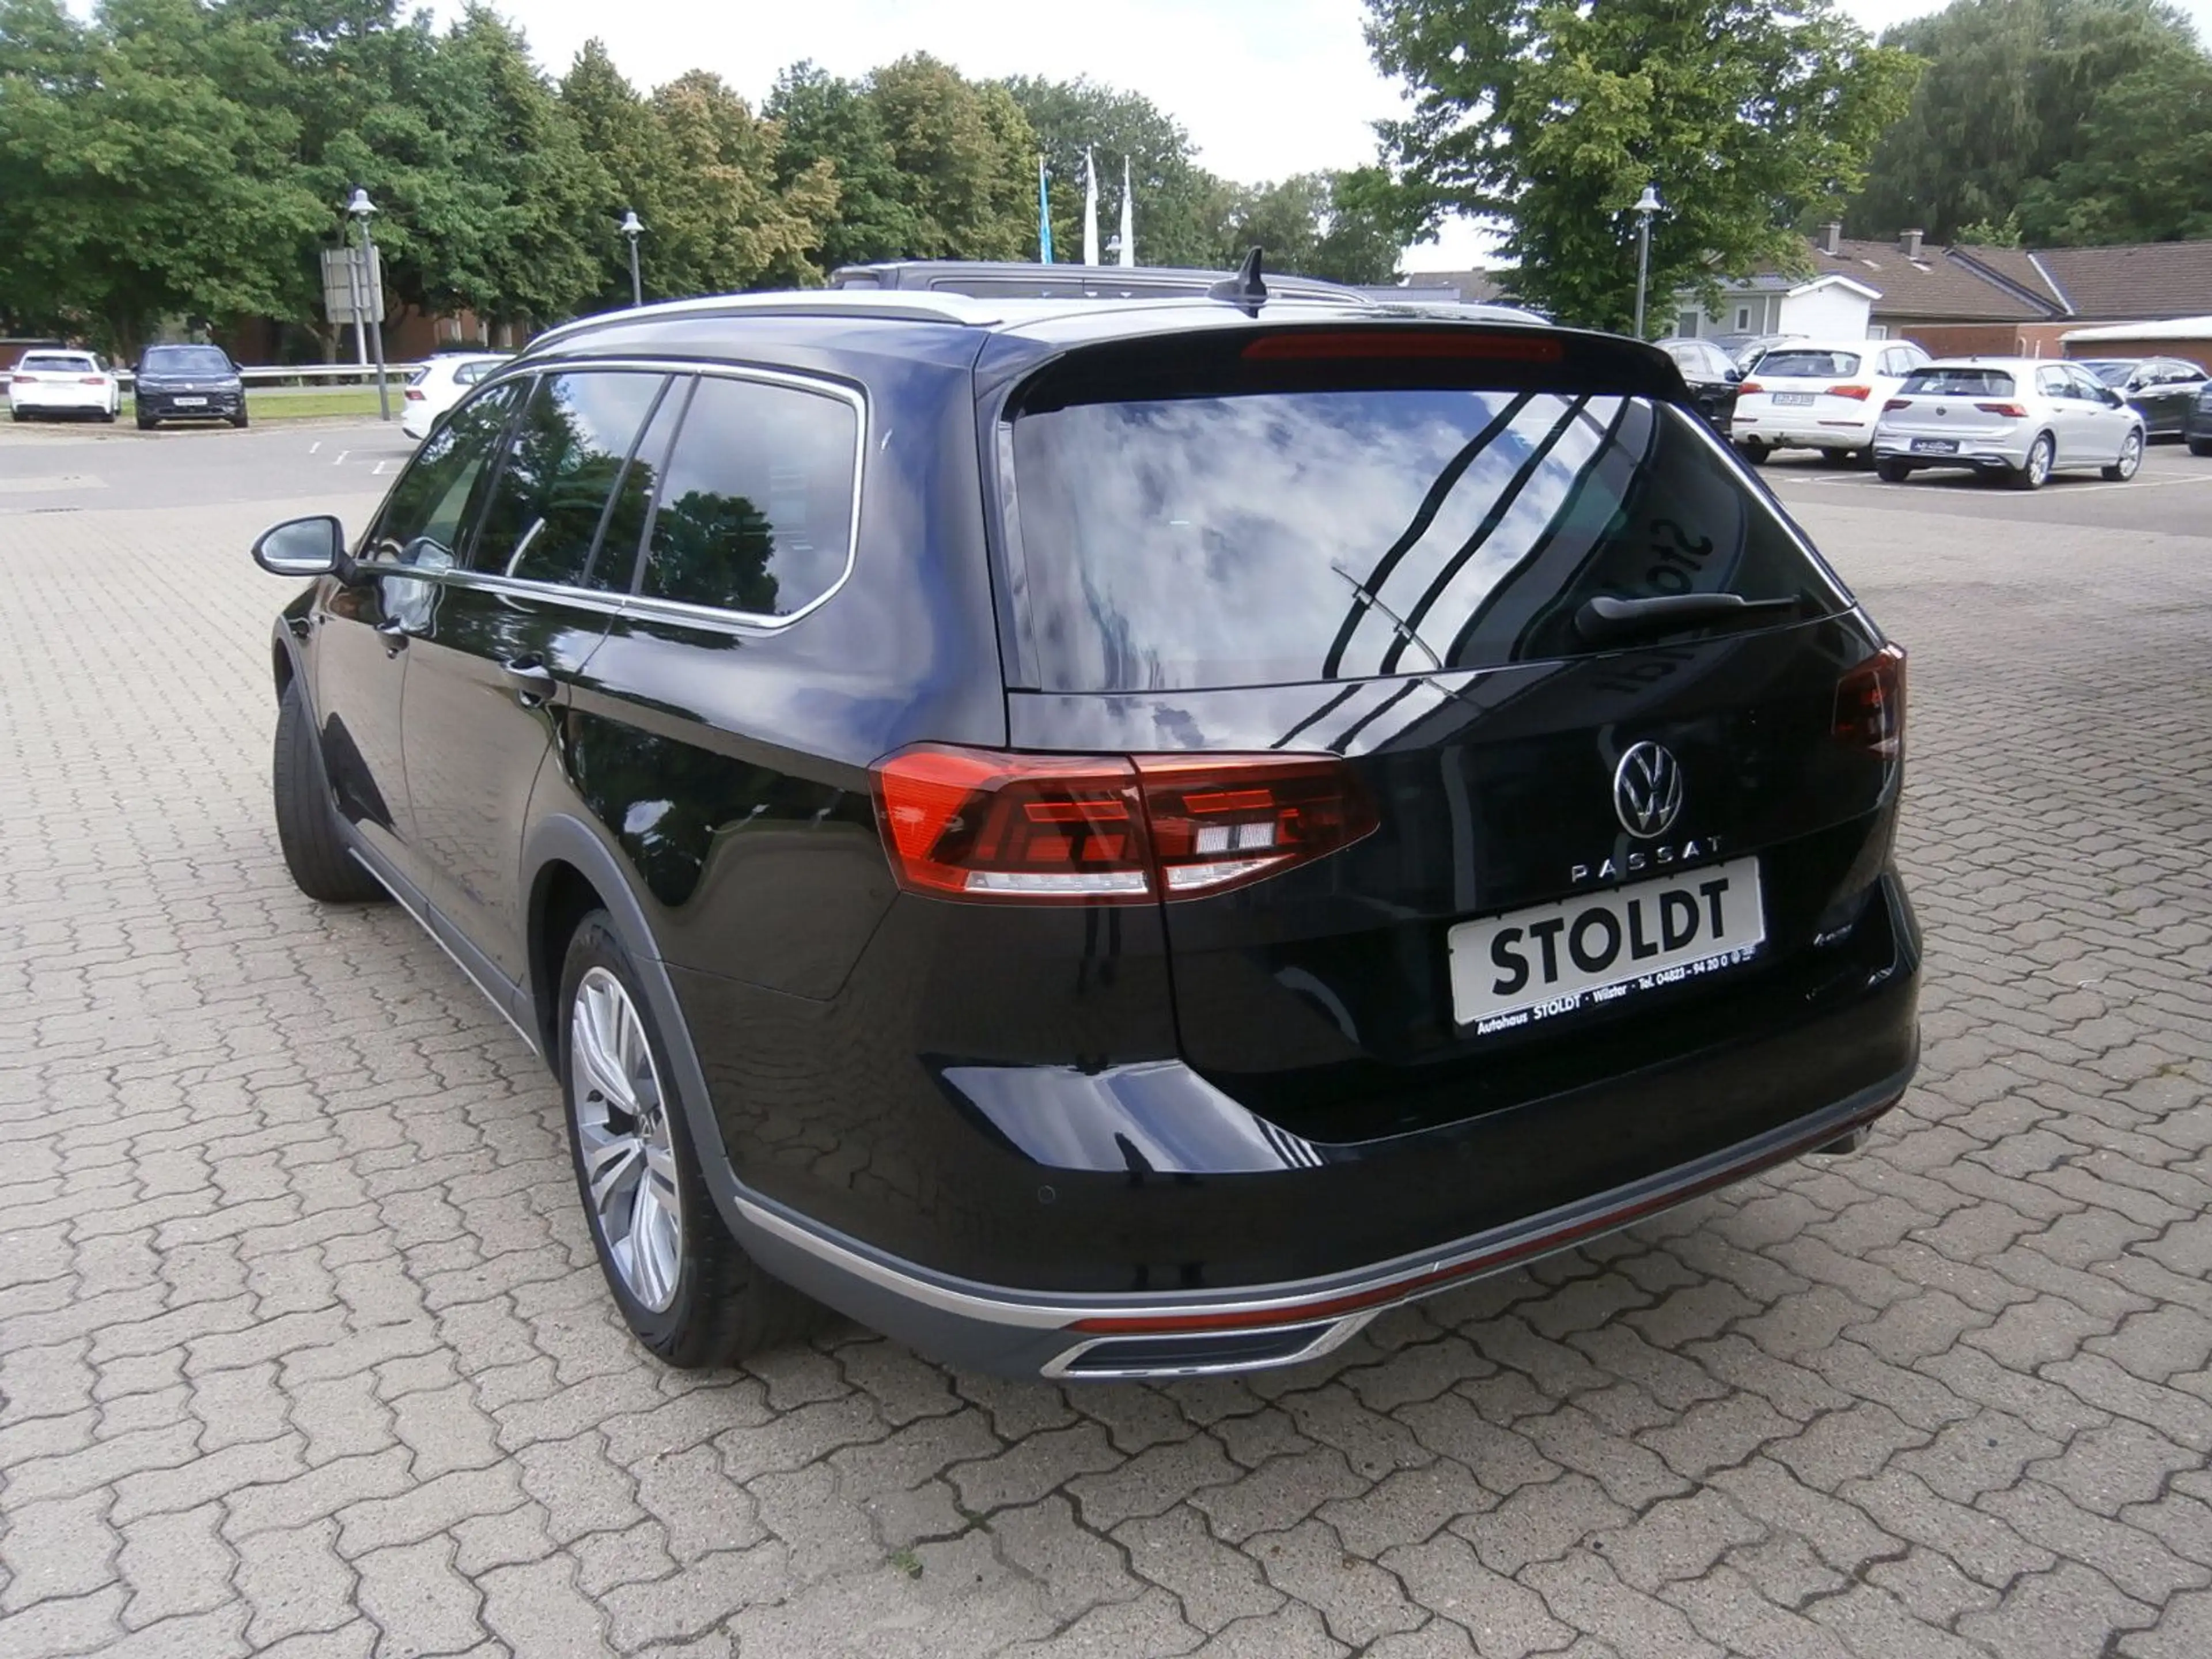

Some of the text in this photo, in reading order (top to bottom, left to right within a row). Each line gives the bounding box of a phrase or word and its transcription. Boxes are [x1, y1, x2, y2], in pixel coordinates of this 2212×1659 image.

[1571, 836, 1722, 882] PASSAT
[1490, 878, 1729, 995] STOLDT
[1477, 1012, 1528, 1035] Autohaus
[1533, 993, 1582, 1020] STOLDT
[1638, 976, 1655, 990] Tel.
